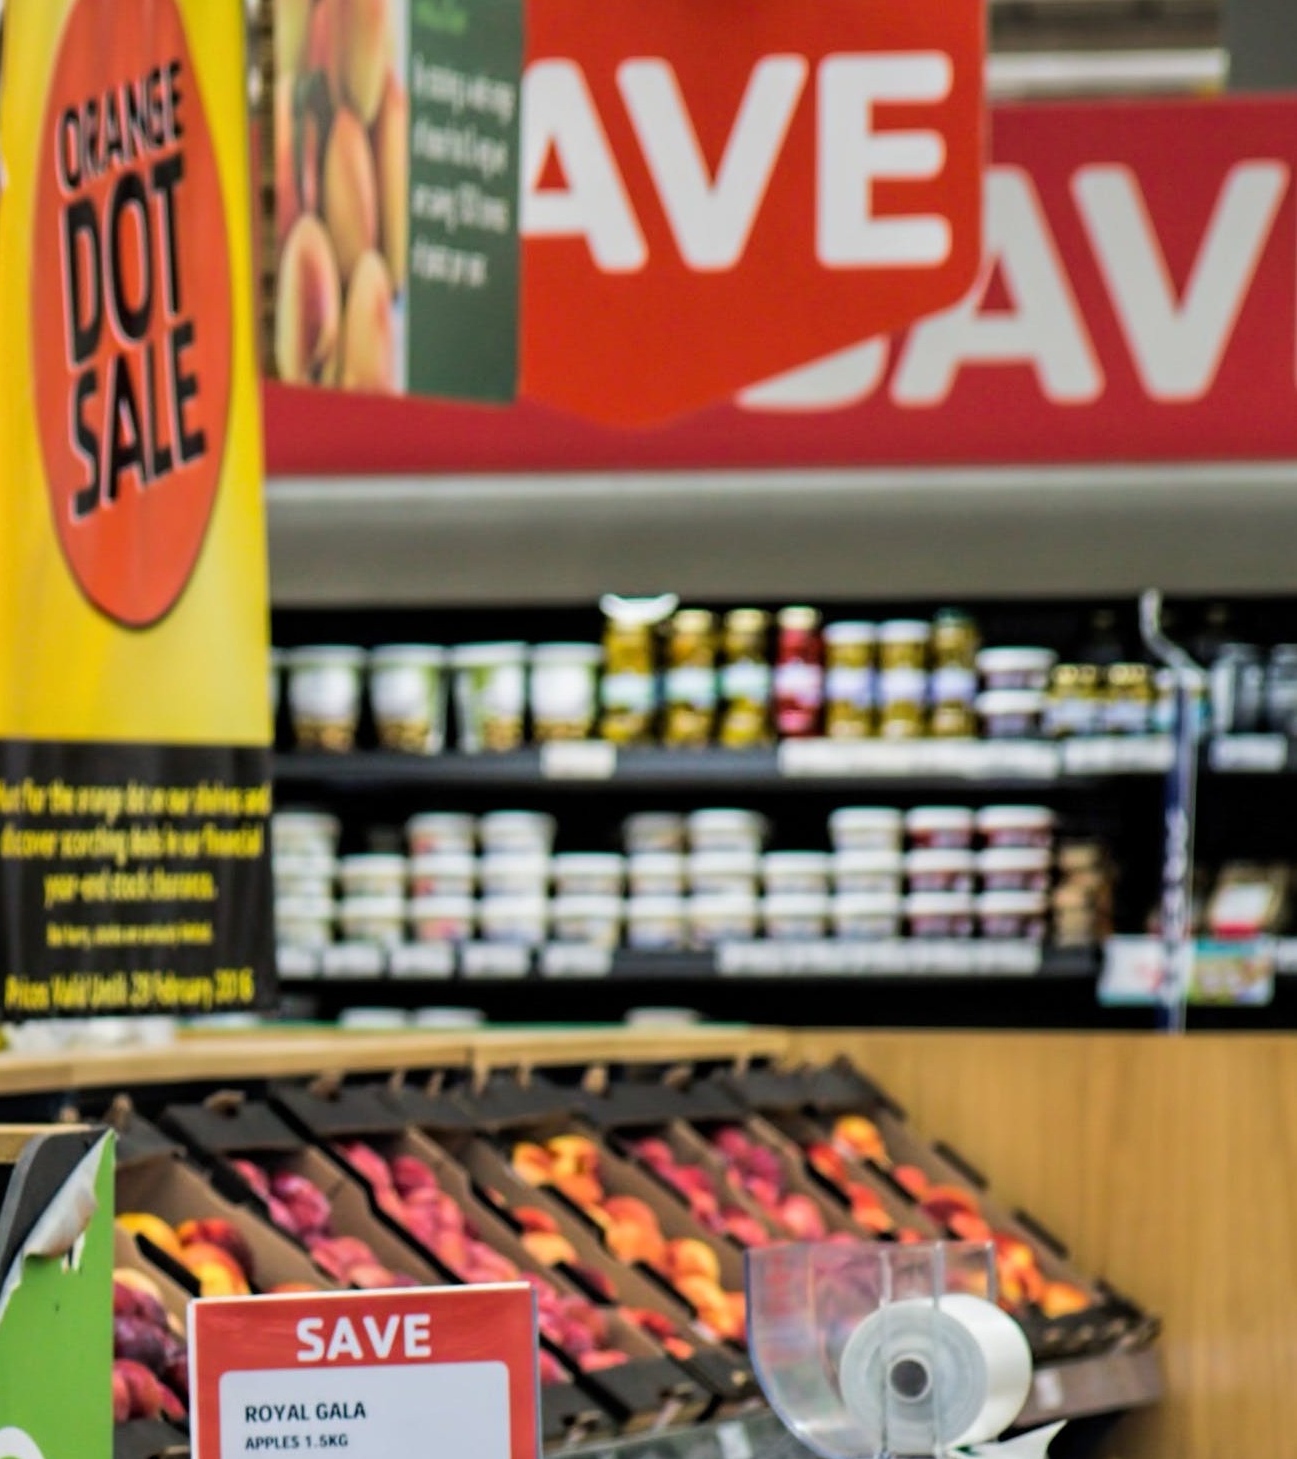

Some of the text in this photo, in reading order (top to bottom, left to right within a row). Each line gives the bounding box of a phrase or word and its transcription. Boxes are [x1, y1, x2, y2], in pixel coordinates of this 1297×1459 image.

[55, 58, 186, 196] ORANGE
[58, 152, 186, 370] DOT
[68, 324, 210, 524] SALE
[5, 974, 49, 1011] Prices
[295, 1313, 433, 1362] SAVE
[244, 1401, 367, 1424] ROYAL GALA
[244, 1433, 349, 1450] APPLES 1.5KG
